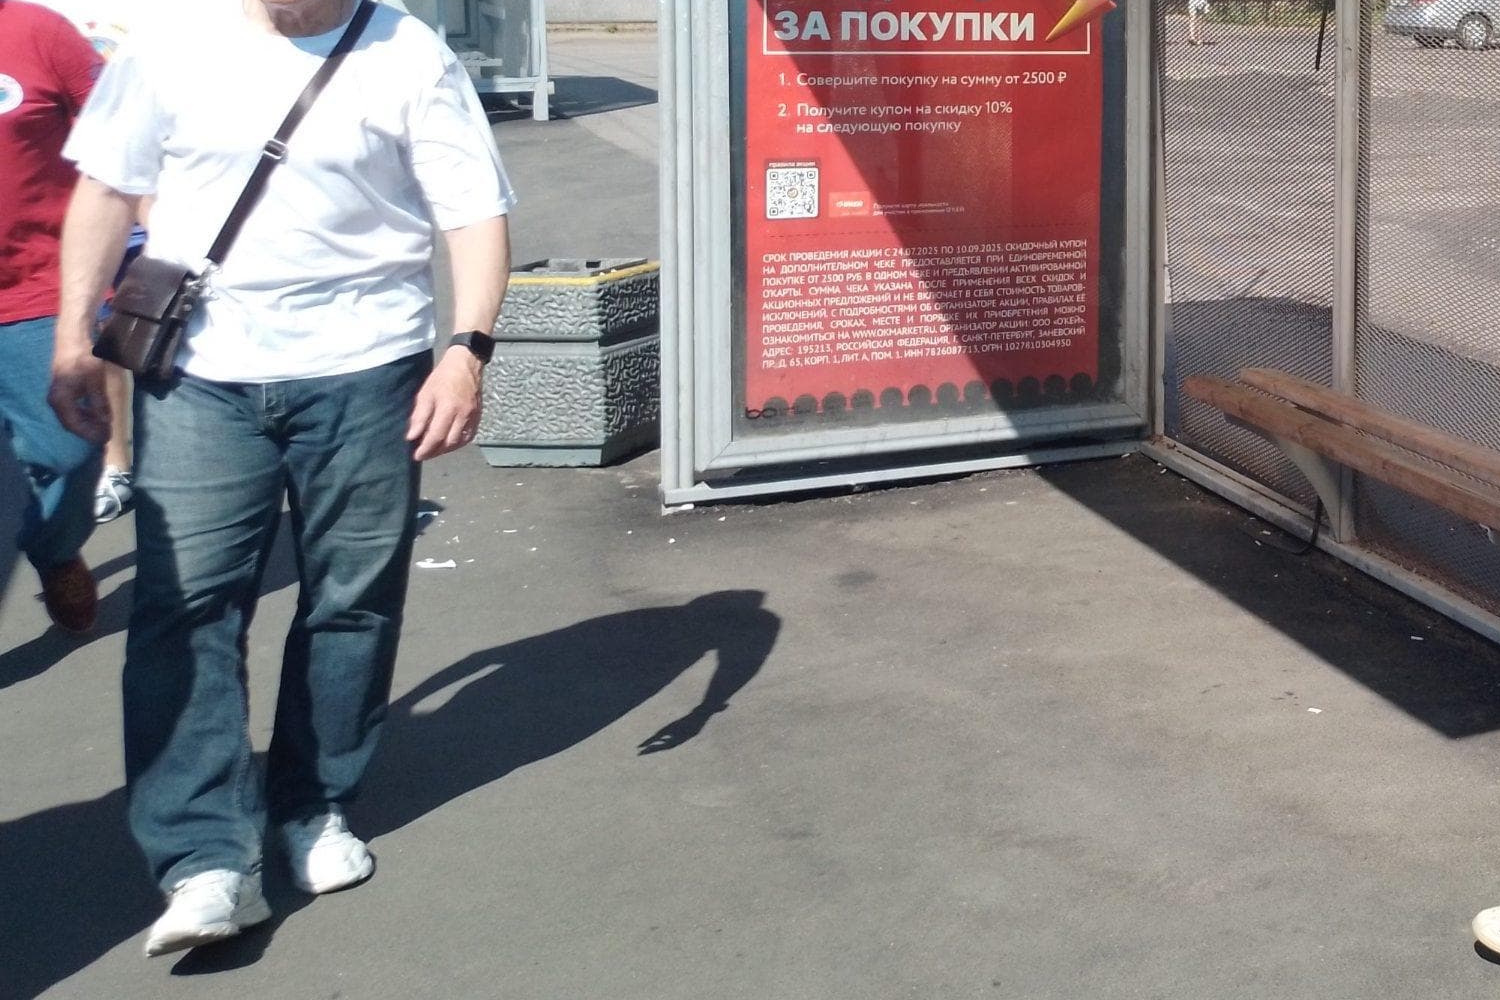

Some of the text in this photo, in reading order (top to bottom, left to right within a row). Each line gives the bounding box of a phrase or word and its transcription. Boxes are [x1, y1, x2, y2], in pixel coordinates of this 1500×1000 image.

[774, 10, 1035, 42] ЗА ПОКУПКИ
[778, 73, 791, 86] 1.
[796, 73, 878, 87] Совершите
[881, 74, 939, 88] покупку
[941, 75, 958, 85] на
[961, 75, 1002, 87] сумму
[1005, 75, 1020, 84] от
[1022, 72, 1055, 84] 2500
[796, 104, 868, 119] Получите
[870, 106, 912, 117] купон
[915, 105, 932, 115] на
[934, 104, 982, 116] скидку
[985, 102, 1013, 113] 10%
[796, 121, 962, 134] на следующую покупку
[762, 253, 787, 263] СРОК
[789, 250, 849, 261] ПРОВЕДЕНИЯ
[850, 249, 882, 258] АКЦИИ
[941, 245, 954, 254] ПО
[1005, 239, 1058, 252] СКИДОЧНЫЙ
[1060, 239, 1087, 248] КУПОН
[762, 249, 1087, 274] НА ДОПОЛНИТЕЛЬНОМ ЧЕКЕ ПРЕДОСТАВЛЯЕТСЯ ПРИ ЕДИНОВРЕМЕННОЙ
[762, 276, 805, 286] ПОКУПКЕ
[808, 275, 820, 284] ОТ
[822, 274, 844, 283] 2500
[874, 270, 907, 280] ОДНОМ
[909, 269, 931, 278] ЧЕКЕ
[941, 263, 1009, 276] ПРЕДЪЯВЛЕНИИ
[809, 286, 841, 295] СУММА
[846, 283, 869, 292] ЧЕКА
[874, 281, 913, 291] УКАЗАНА
[918, 279, 947, 289] ПОСЛЕ
[952, 276, 1011, 287] ПРИМЕНЕНИЯ
[1016, 275, 1037, 284] ВСЕХ
[1041, 273, 1075, 283] СКИДОК
[762, 299, 821, 310] АКЦИОННЫХ
[823, 293, 891, 306] ПРЕДЛОЖЕНИЙ
[903, 292, 915, 300] НЕ
[917, 289, 963, 300] ВКЛЮЧАЕТ
[973, 288, 994, 298] СЕБЯ
[996, 285, 1046, 296] СТОИМОСТЬ
[839, 304, 918, 317] ПОДРОБНОСТЯМИ
[919, 303, 932, 312] ОБ
[934, 299, 997, 311] ОРГАНИЗАТОРЕ
[1032, 294, 1075, 304] ПРАВИЛАХ
[872, 316, 901, 326] МЕСТЕ
[919, 312, 960, 323] ПОРЯДКЕ
[965, 311, 978, 319] ИХ
[984, 307, 1049, 319] ПРИОБРЕТЕНИЯ
[1054, 305, 1086, 315] МОЖНО
[762, 332, 835, 346] ОЗНАКОМИТЬСЯ
[837, 330, 851, 339] НА
[939, 321, 997, 334] ОРГАНИЗАТОР
[1032, 318, 1051, 327] ООО
[836, 338, 894, 352] РОССИЙСКАЯ
[1038, 325, 1086, 338] ЗАНЕВСКИЙ
[904, 347, 924, 358] ИНН
[981, 343, 1002, 353] ОГРН
